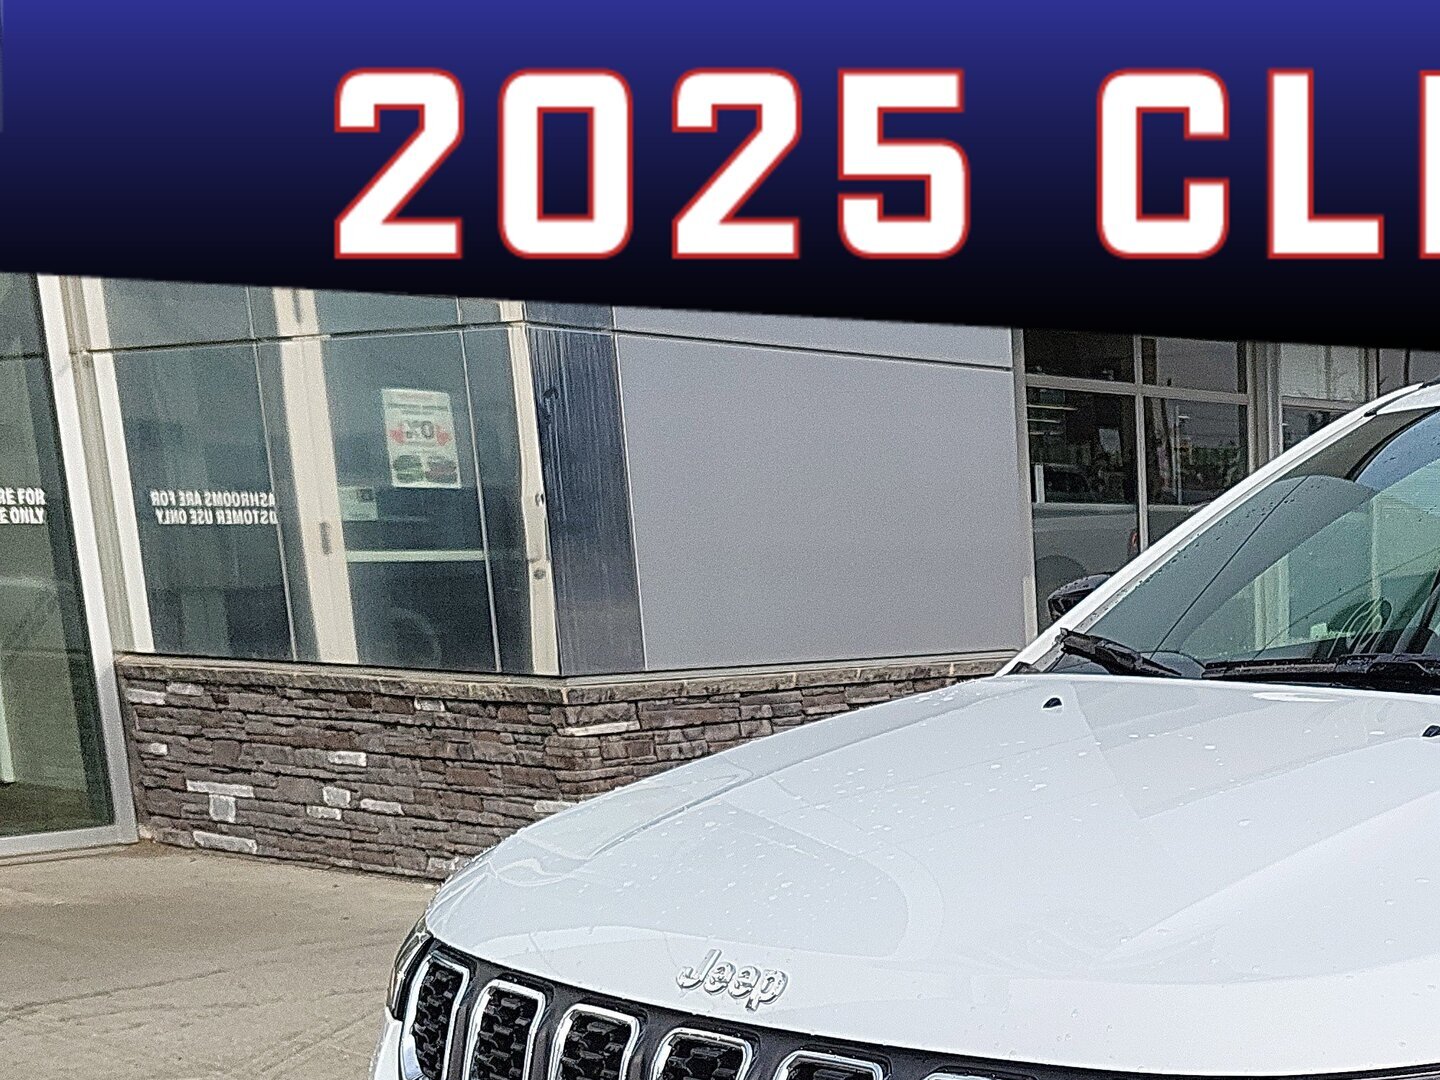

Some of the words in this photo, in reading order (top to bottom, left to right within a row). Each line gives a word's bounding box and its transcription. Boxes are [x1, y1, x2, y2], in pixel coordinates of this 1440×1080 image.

[17, 487, 47, 506] FOR
[9, 506, 45, 524] ONLY
[675, 948, 789, 1012] Jeep
